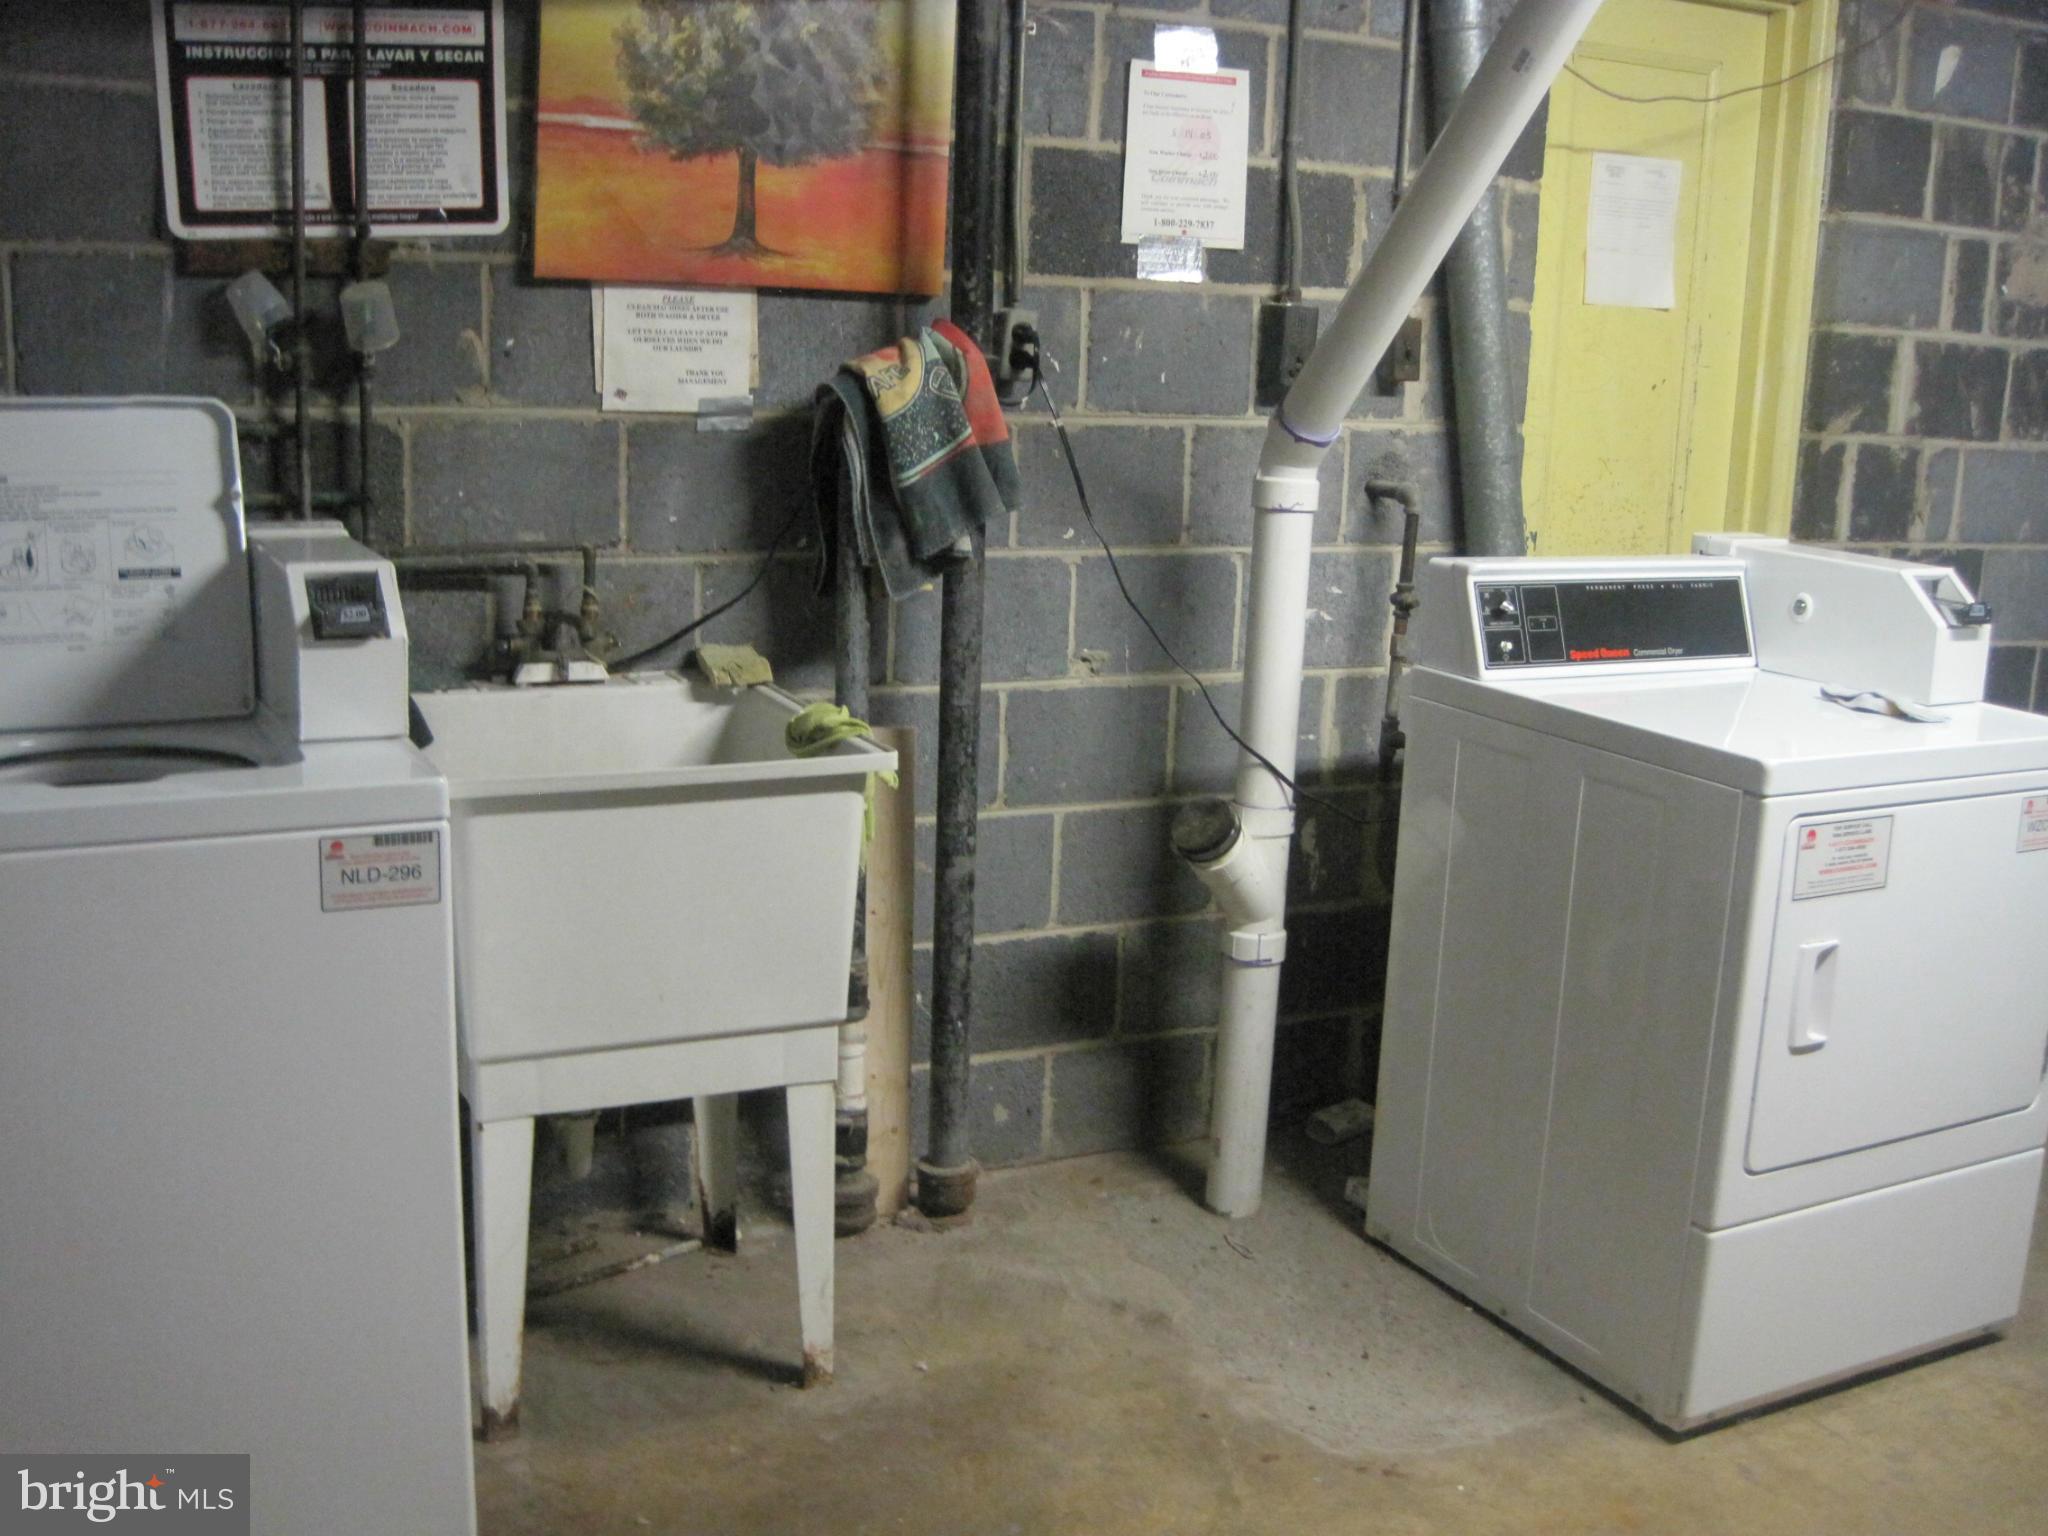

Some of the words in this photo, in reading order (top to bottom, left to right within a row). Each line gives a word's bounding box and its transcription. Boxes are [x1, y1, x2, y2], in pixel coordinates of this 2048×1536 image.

[185, 46, 316, 61] INSTRUCCIOS
[366, 49, 415, 62] LAVAR
[420, 50, 430, 62] Y
[434, 50, 485, 63] SECAR
[662, 295, 695, 305] PLEASE
[635, 311, 657, 319] BOTH
[696, 313, 721, 321] DRYER
[652, 344, 669, 352] OUR
[669, 345, 703, 353] LAUNDRY
[685, 369, 709, 377] THANK
[710, 369, 724, 377] YOU
[677, 377, 728, 385] MANAGEMENT
[1569, 647, 1600, 661] Speed
[1632, 647, 1667, 657] Commercial
[1667, 646, 1684, 656] Dryer
[341, 864, 422, 885] NLD-296
